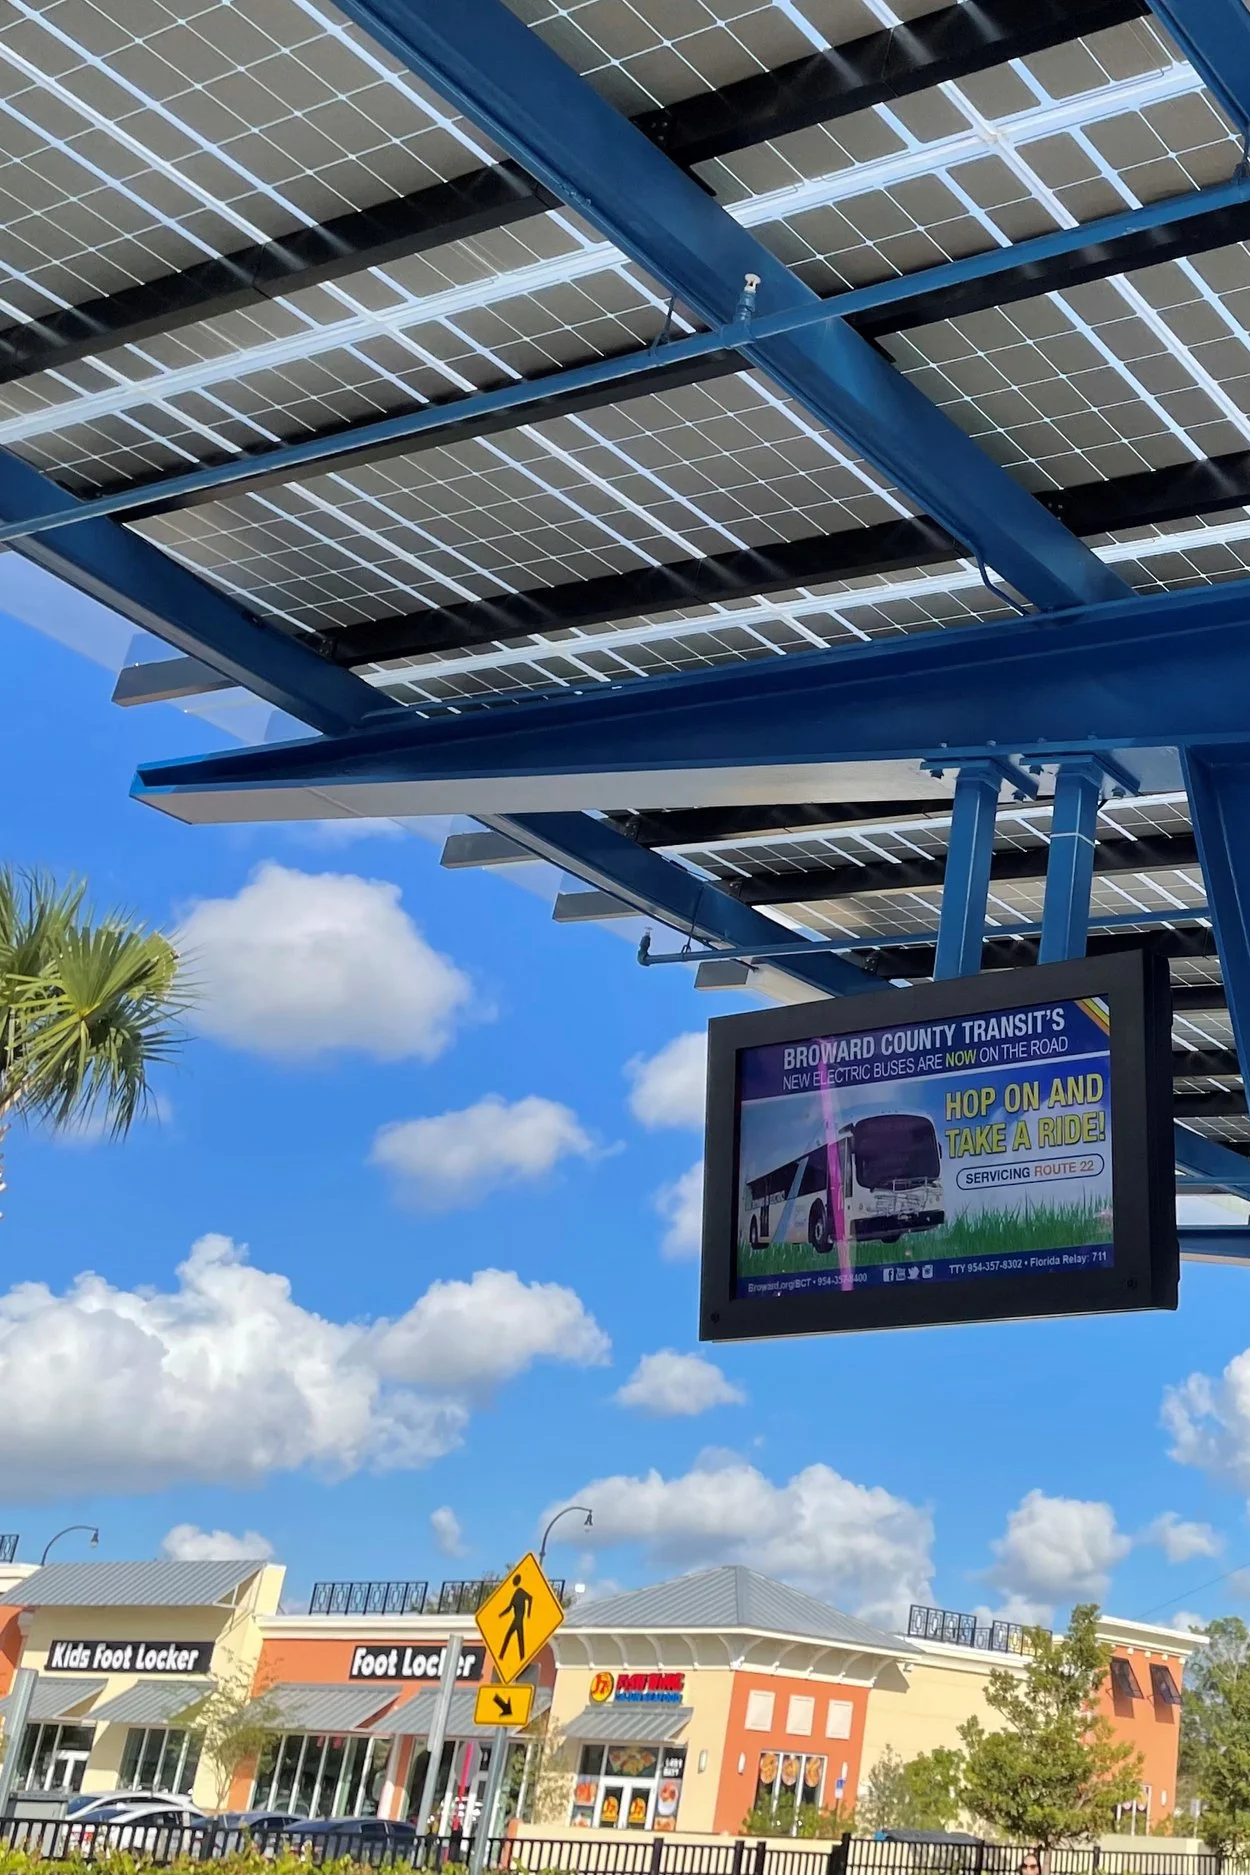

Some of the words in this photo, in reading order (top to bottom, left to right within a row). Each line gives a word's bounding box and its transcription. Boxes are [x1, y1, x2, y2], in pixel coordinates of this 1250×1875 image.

[783, 1036, 875, 1071] BROWARD
[881, 1023, 956, 1056] COUNTY
[961, 1007, 1065, 1044] TRANSIT'S
[783, 1072, 812, 1090] NEW
[813, 1064, 871, 1087] ELECTRIC
[873, 1057, 914, 1078] BUSES
[917, 1053, 942, 1072] ARE
[945, 1050, 977, 1068] NOW
[979, 1045, 999, 1063] ON
[1001, 1041, 1028, 1060] THE
[1030, 1036, 1068, 1056] ROAD
[945, 1086, 997, 1121] HOP
[1004, 1081, 1040, 1113] ON
[1048, 1073, 1104, 1109] AND
[945, 1122, 1007, 1159] TAKE
[1012, 1119, 1032, 1151] A
[1037, 1111, 1106, 1148] RIDE!
[965, 1167, 1030, 1185] SERVICING
[1034, 1162, 1077, 1178] ROUTE
[1080, 1160, 1094, 1173] 22
[949, 1263, 966, 1275] TTY
[967, 1259, 1022, 1273] 954-357-8302
[1029, 1255, 1060, 1268] Florida
[1092, 1251, 1107, 1262] 711
[51, 1642, 91, 1669] Kids
[92, 1642, 133, 1670] Foot
[135, 1643, 200, 1671] Locker
[351, 1647, 398, 1677] Foot
